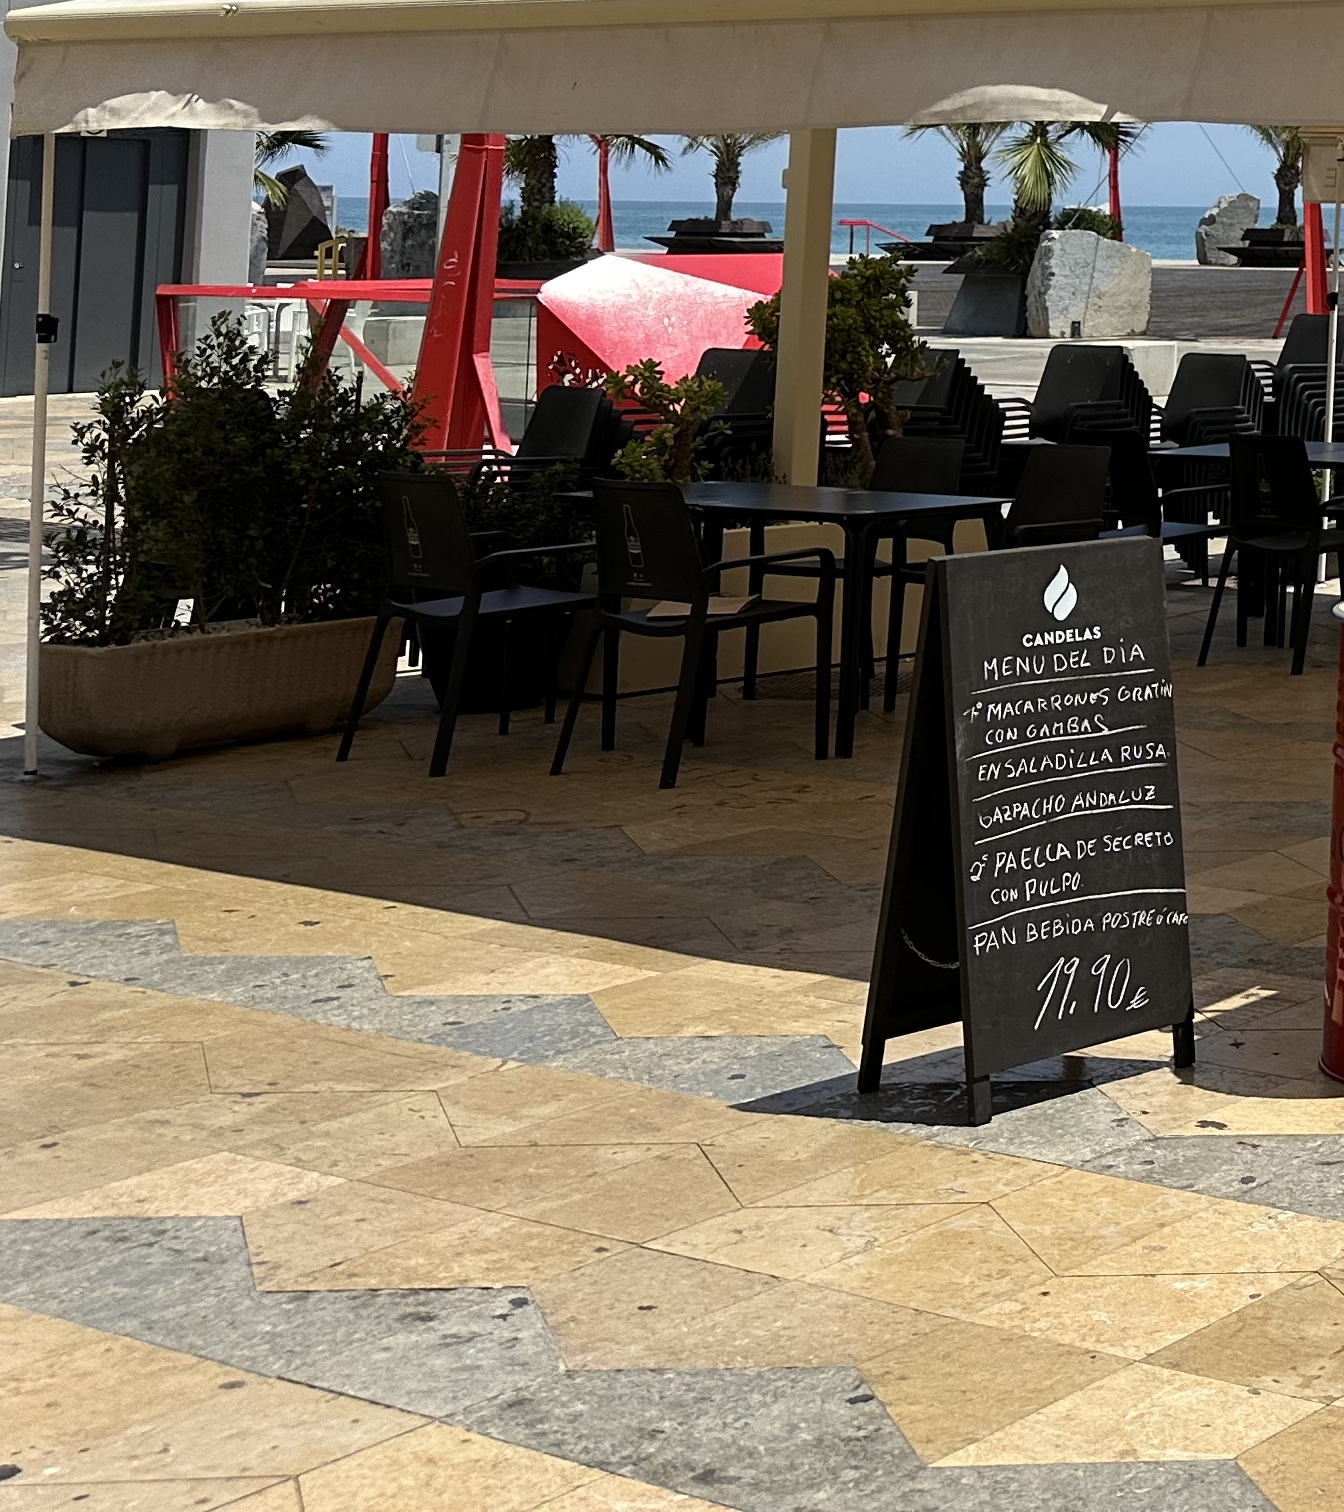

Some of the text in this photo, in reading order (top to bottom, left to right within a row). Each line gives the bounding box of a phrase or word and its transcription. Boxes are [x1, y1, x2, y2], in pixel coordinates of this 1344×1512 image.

[1022, 625, 1102, 648] CANDELAS
[983, 654, 1046, 681] MENU
[1053, 648, 1092, 673] DEL
[986, 687, 1112, 723] MACARRONES
[985, 713, 1112, 746] CON GAMBAS
[978, 785, 1157, 829] GAZPACHO ANDALUZ
[994, 843, 1072, 878] PAELLA
[1077, 838, 1098, 861] DE
[1102, 831, 1174, 853] SECRETO
[990, 887, 1019, 905] CON
[973, 925, 1017, 956] PAN
[1102, 908, 1153, 932] POSTRE
